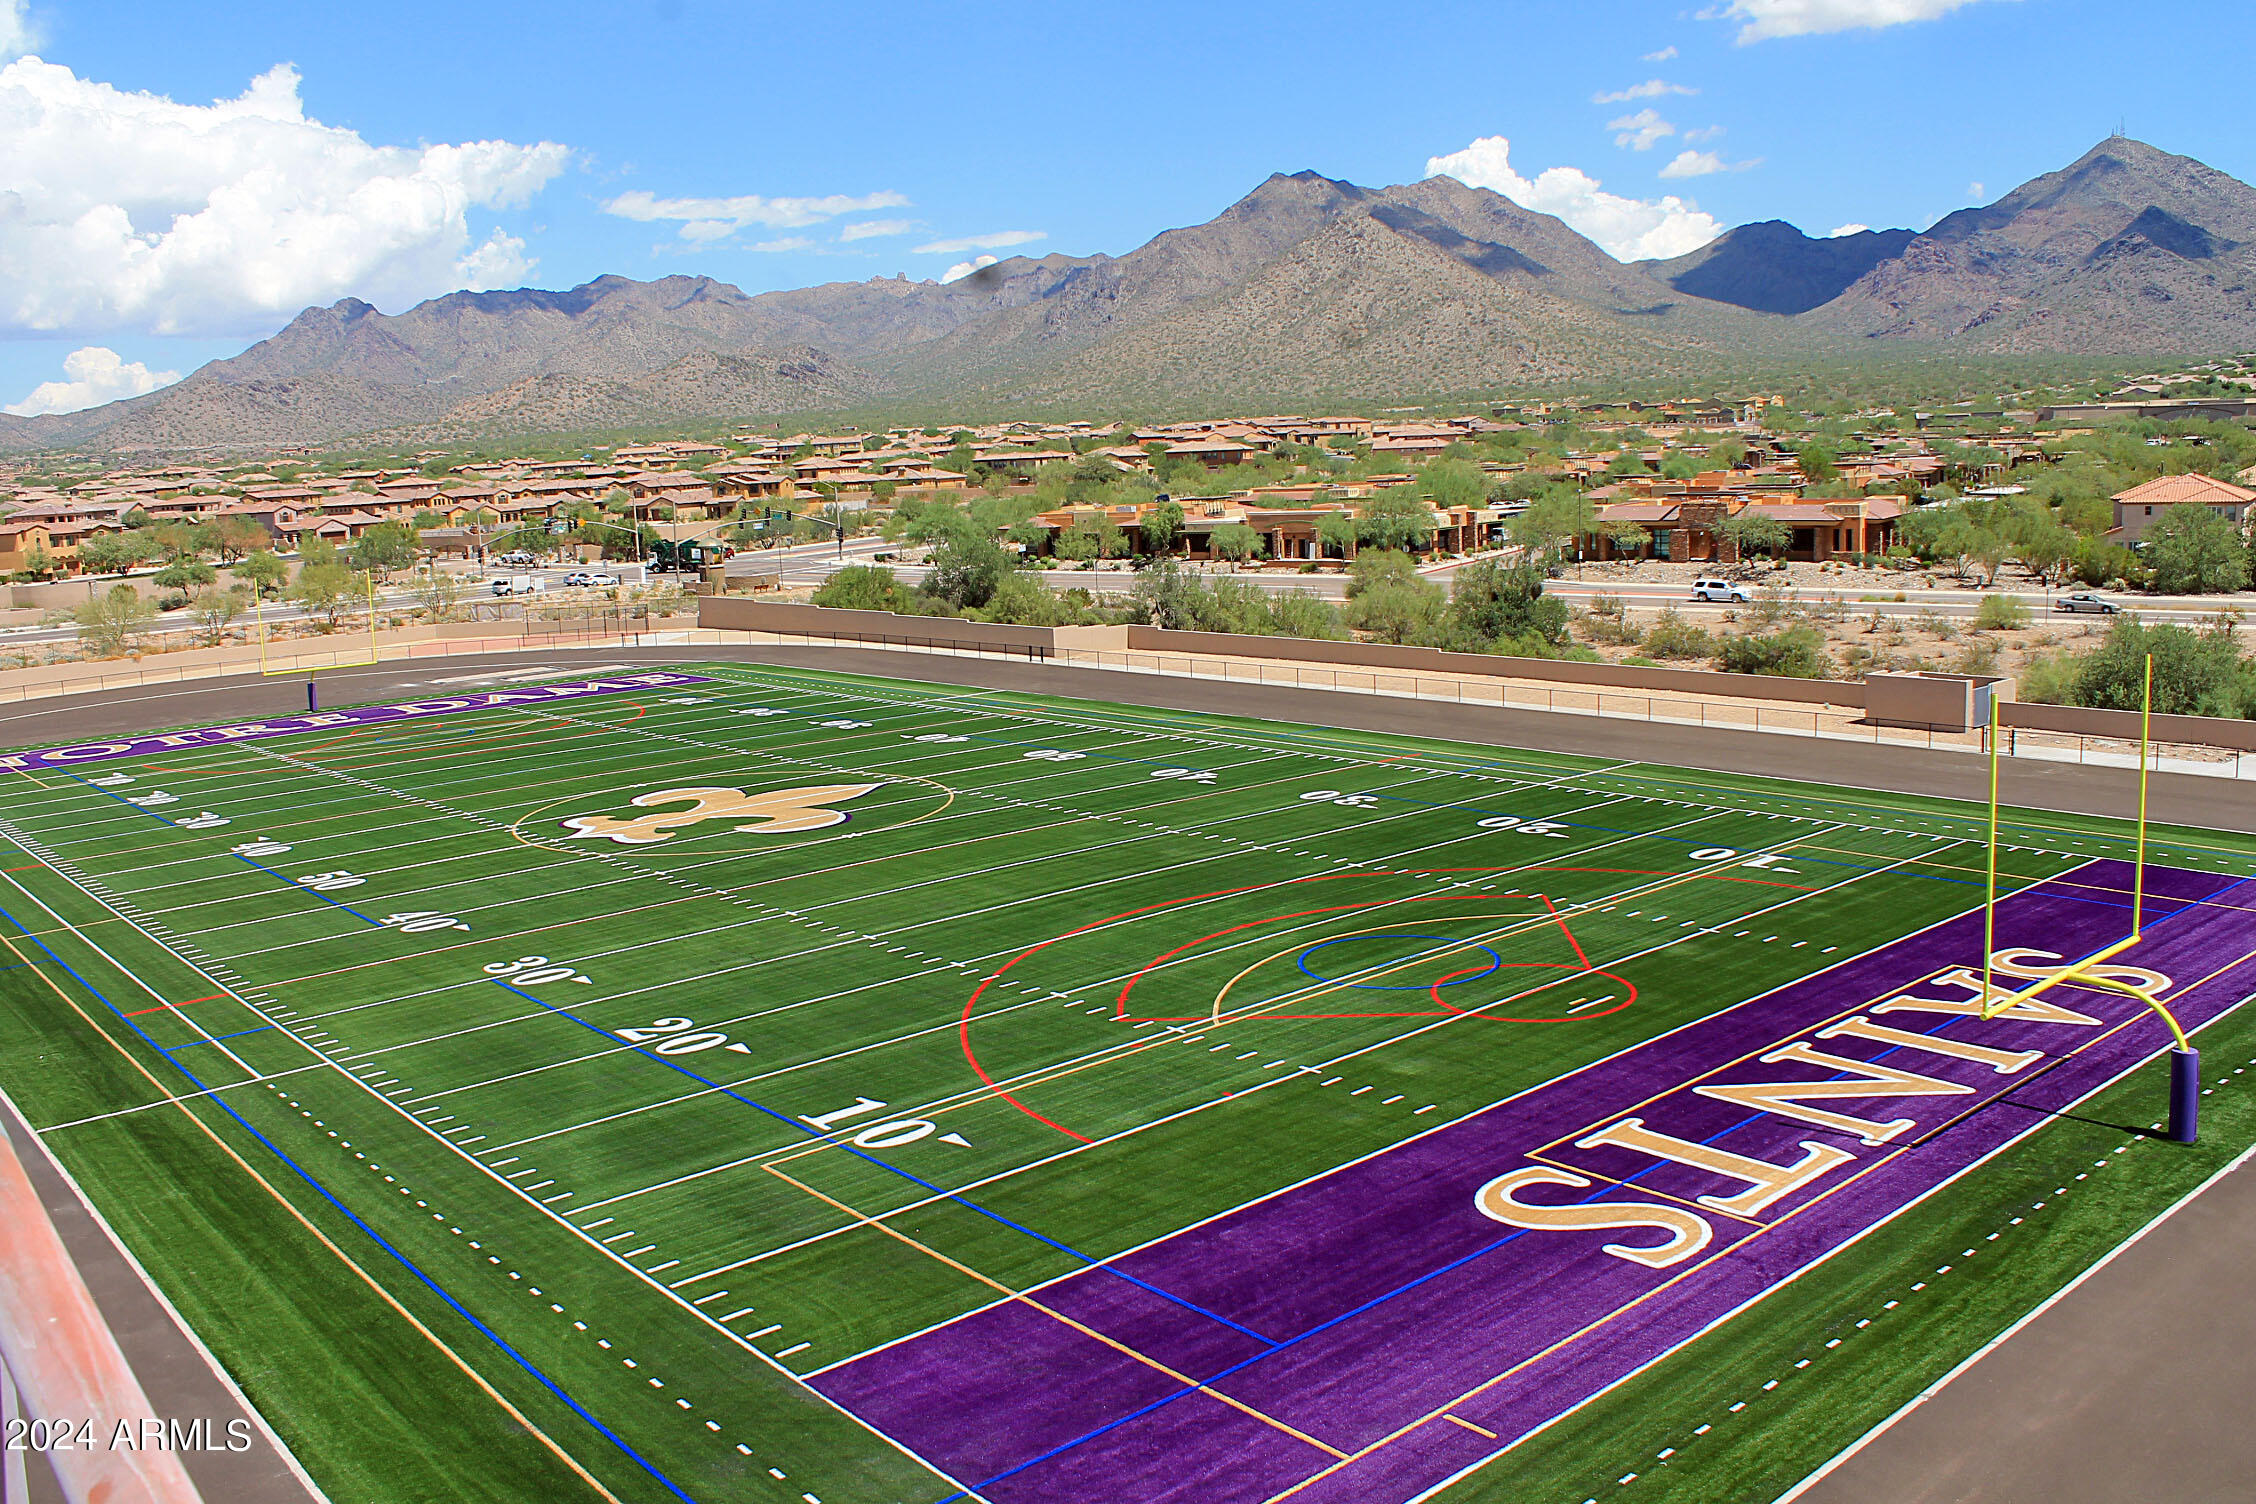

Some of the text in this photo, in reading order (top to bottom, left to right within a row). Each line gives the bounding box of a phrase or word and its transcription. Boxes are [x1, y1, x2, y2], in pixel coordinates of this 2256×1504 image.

[1150, 768, 1218, 781] 40
[1299, 790, 1380, 807] 30
[1476, 816, 1569, 835] 20
[1688, 848, 1793, 869] 10
[297, 870, 367, 891] 50
[380, 910, 460, 933] 40
[482, 956, 576, 987] 30
[614, 1017, 728, 1056] 20
[1474, 947, 2174, 1269] SAINTS
[798, 1096, 937, 1149] 10
